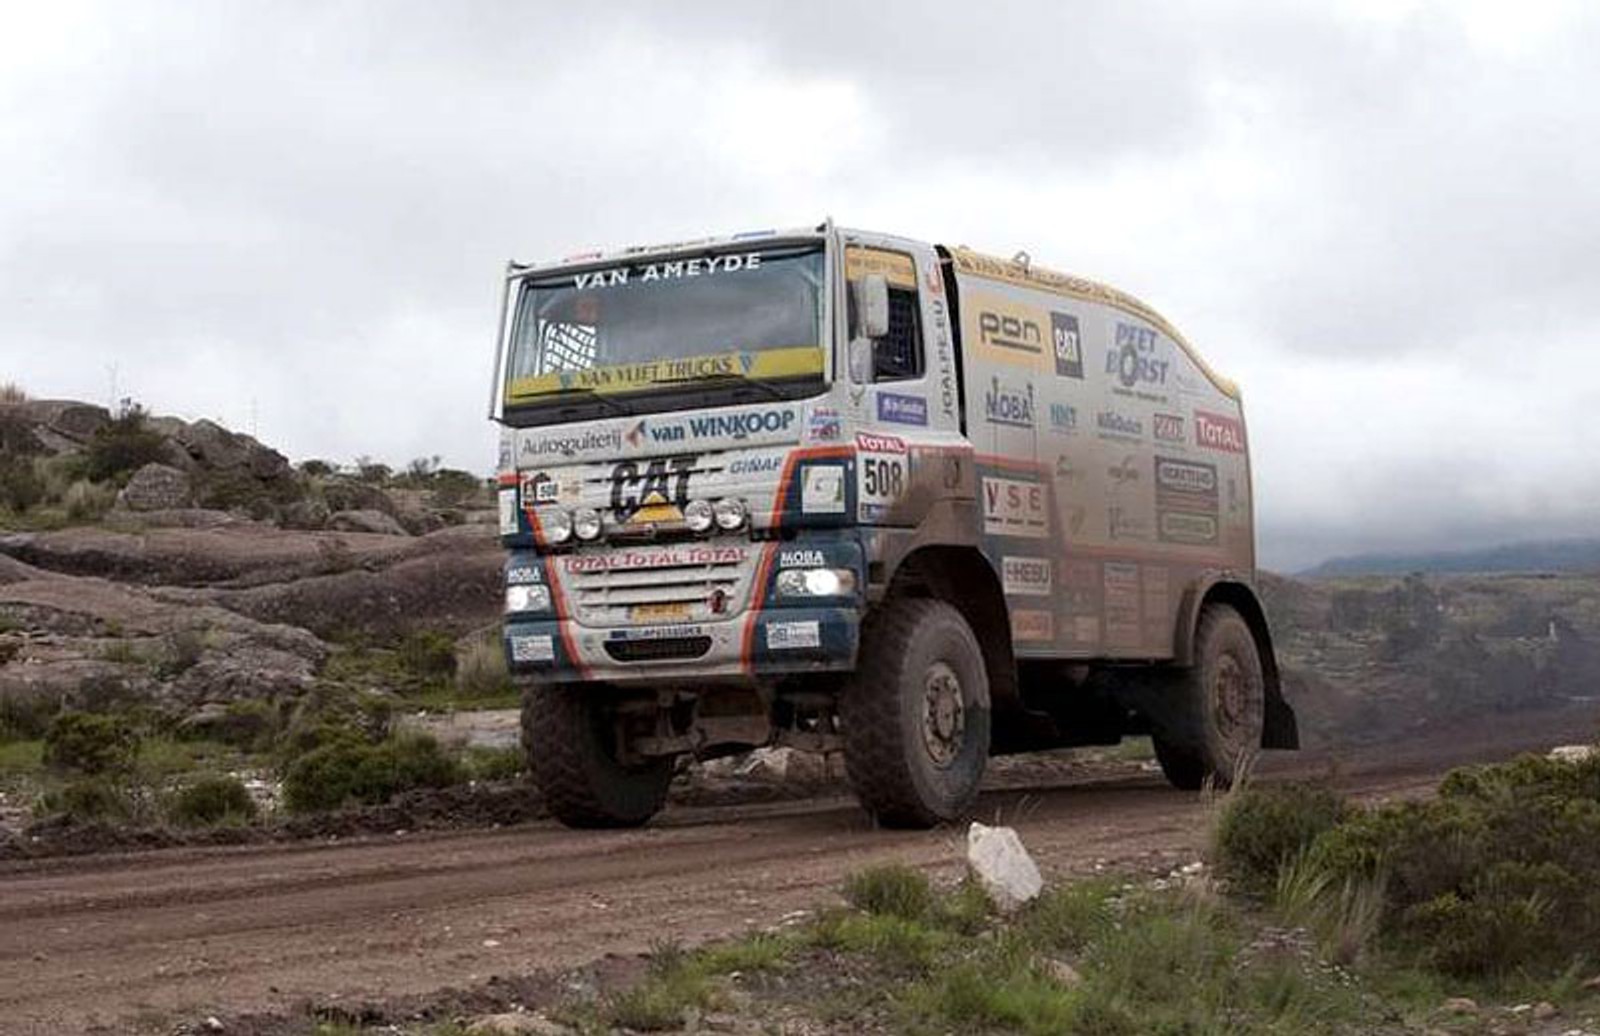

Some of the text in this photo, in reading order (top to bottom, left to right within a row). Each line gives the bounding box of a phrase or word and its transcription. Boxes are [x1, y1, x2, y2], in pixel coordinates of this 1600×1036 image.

[574, 252, 762, 290] VAN AMEYDE
[579, 356, 733, 388] VAN VLIET TRUCKS
[651, 424, 686, 443] van
[690, 409, 795, 439] WINKOOP
[1197, 418, 1242, 448] TOTAL
[858, 436, 904, 453] TOTAL
[610, 455, 700, 527] CAT
[864, 457, 903, 498] 508
[562, 546, 749, 573] TOTAL TOTAL TOTAL
[780, 549, 825, 567] MOBA
